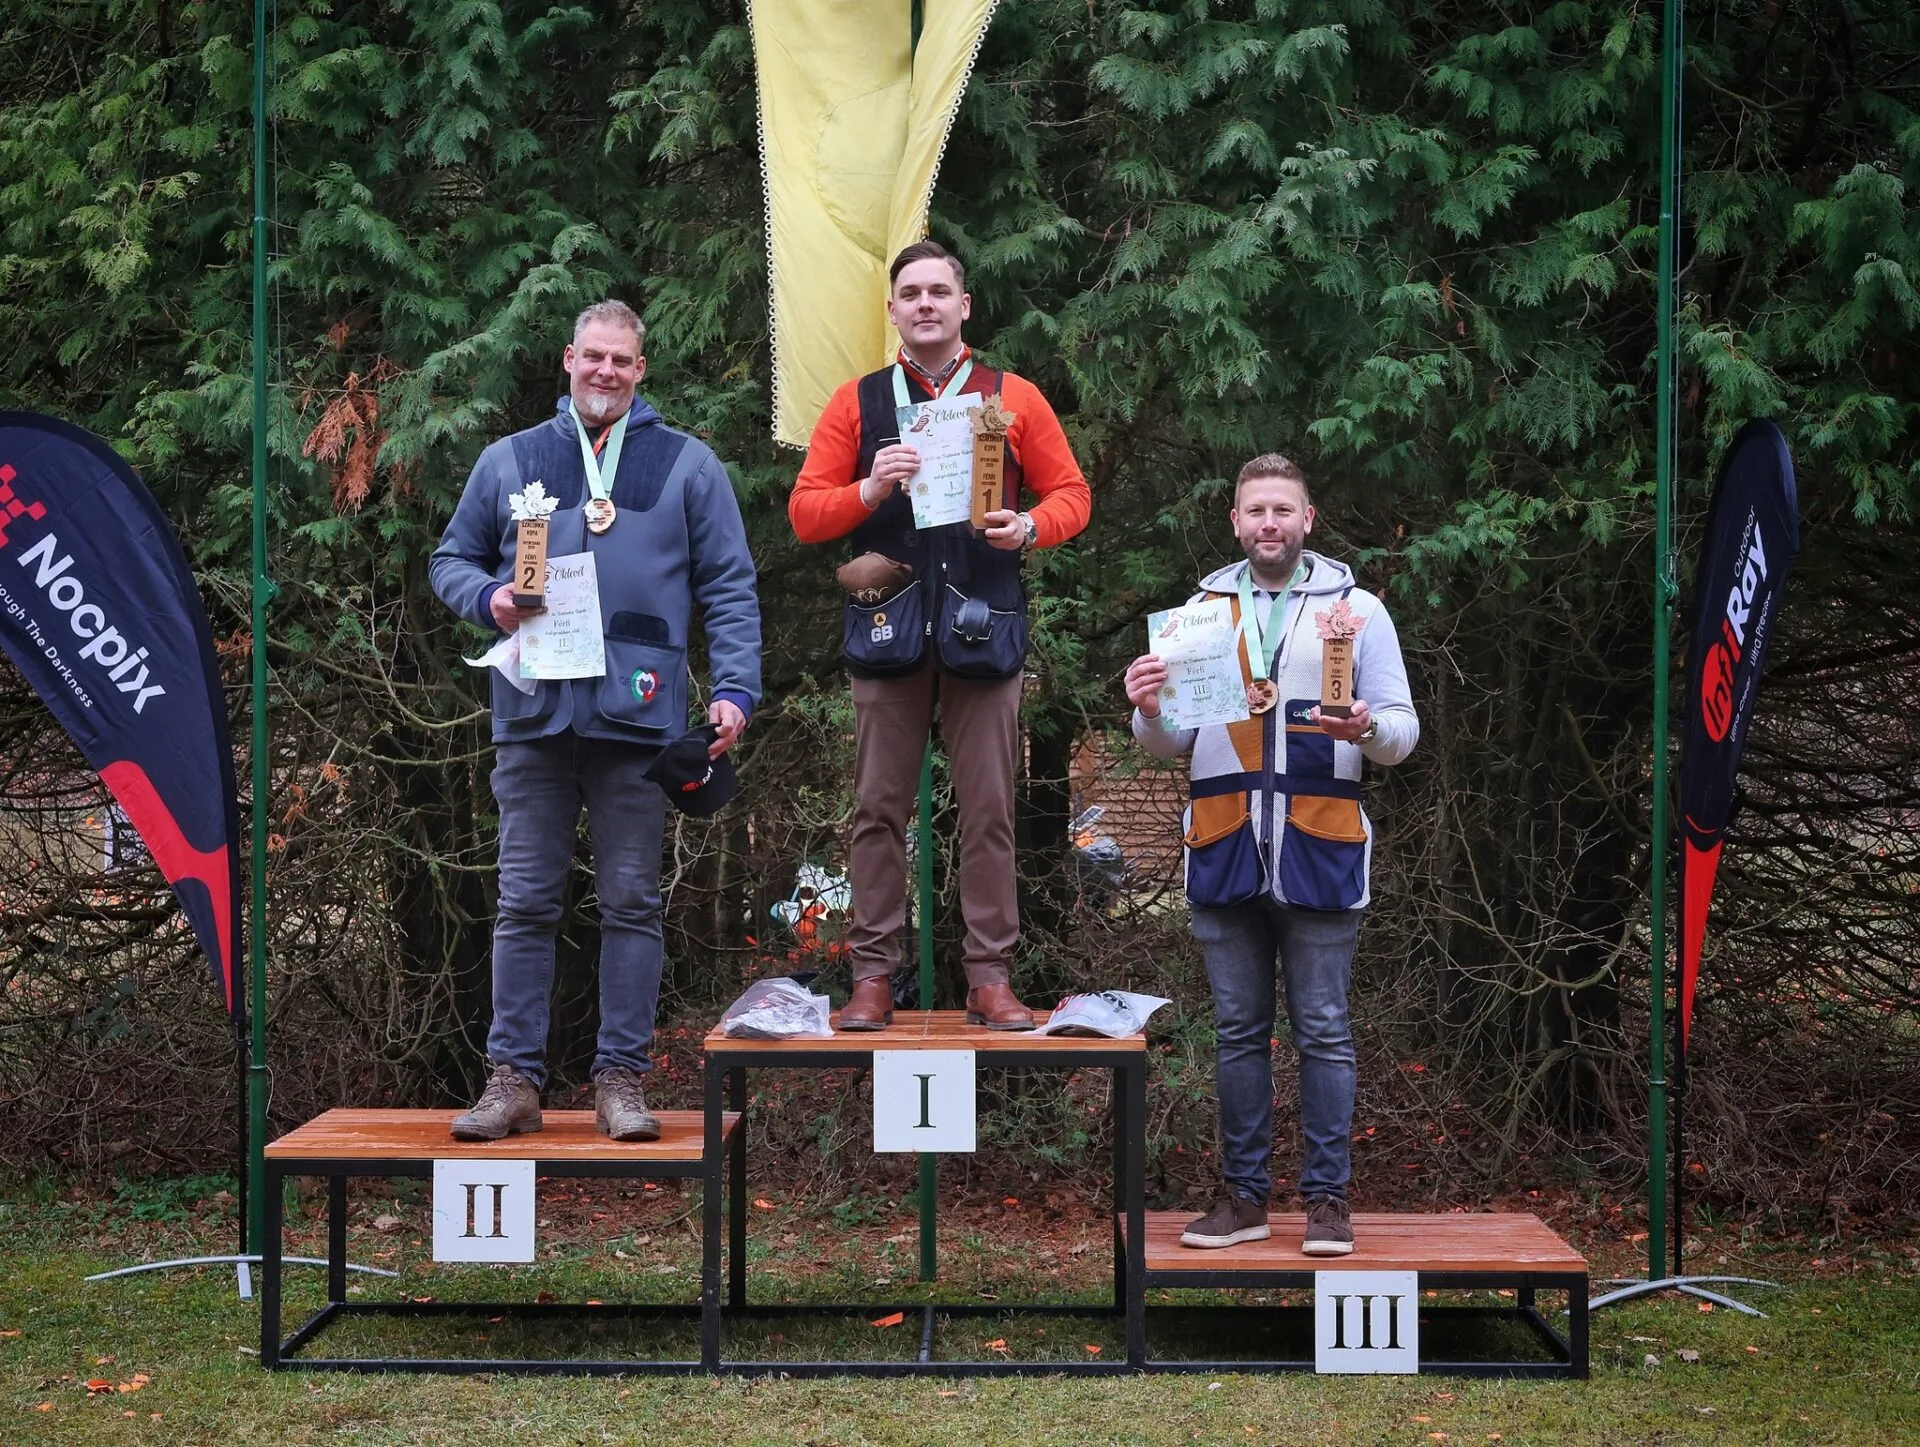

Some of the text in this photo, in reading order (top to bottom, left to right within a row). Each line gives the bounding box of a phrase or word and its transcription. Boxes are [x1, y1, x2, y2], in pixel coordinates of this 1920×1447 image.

[983, 489, 992, 513] 1
[1734, 505, 1755, 578] Outdoor
[522, 567, 536, 590] 2
[0, 584, 94, 708] ough The Darkness
[17, 532, 166, 715] Nocpix
[871, 624, 893, 643] GB
[1331, 680, 1342, 700] 3
[912, 1074, 936, 1128] I
[458, 1183, 509, 1239] II
[1328, 1295, 1405, 1350] III
